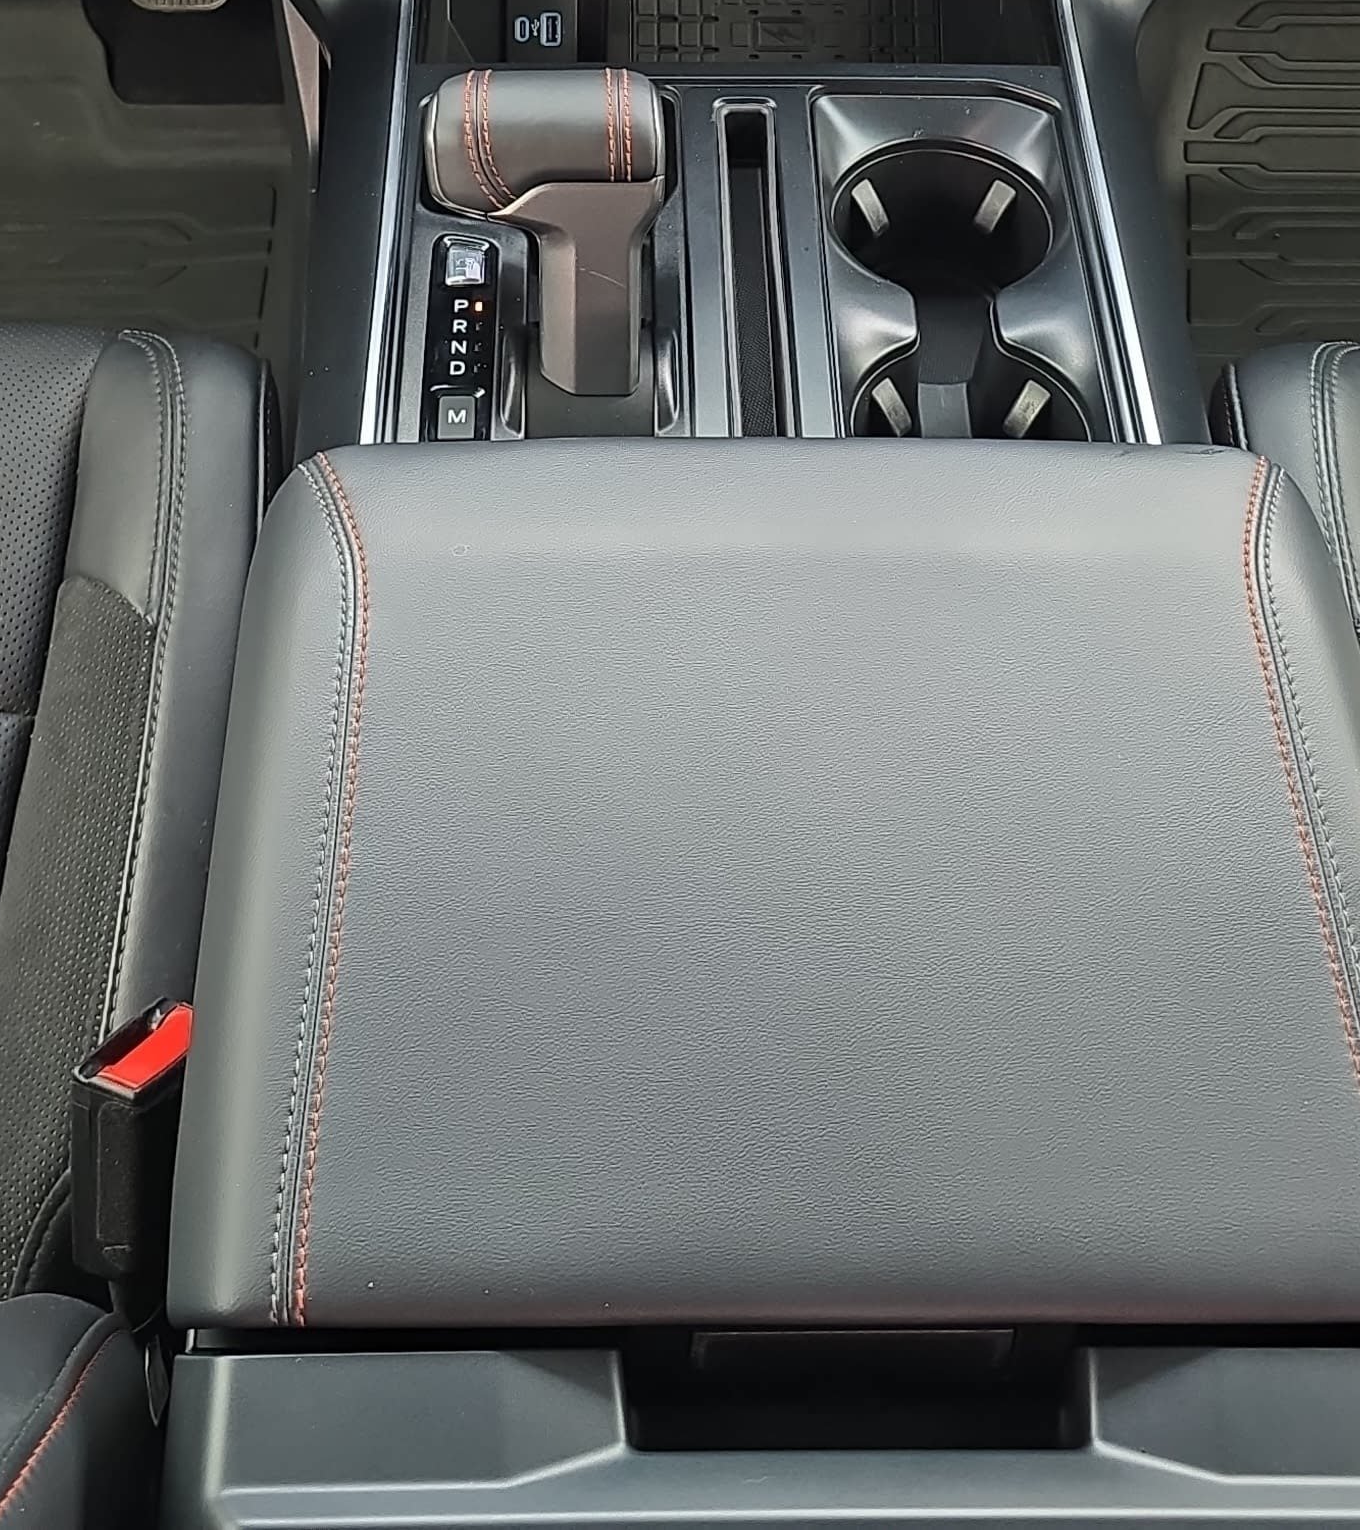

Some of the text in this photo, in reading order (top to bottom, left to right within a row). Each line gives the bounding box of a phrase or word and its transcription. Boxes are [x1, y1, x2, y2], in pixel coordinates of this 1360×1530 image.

[454, 299, 469, 313] P
[452, 320, 468, 334] R
[451, 340, 467, 354] N
[449, 360, 466, 375] D
[448, 409, 467, 423] M
